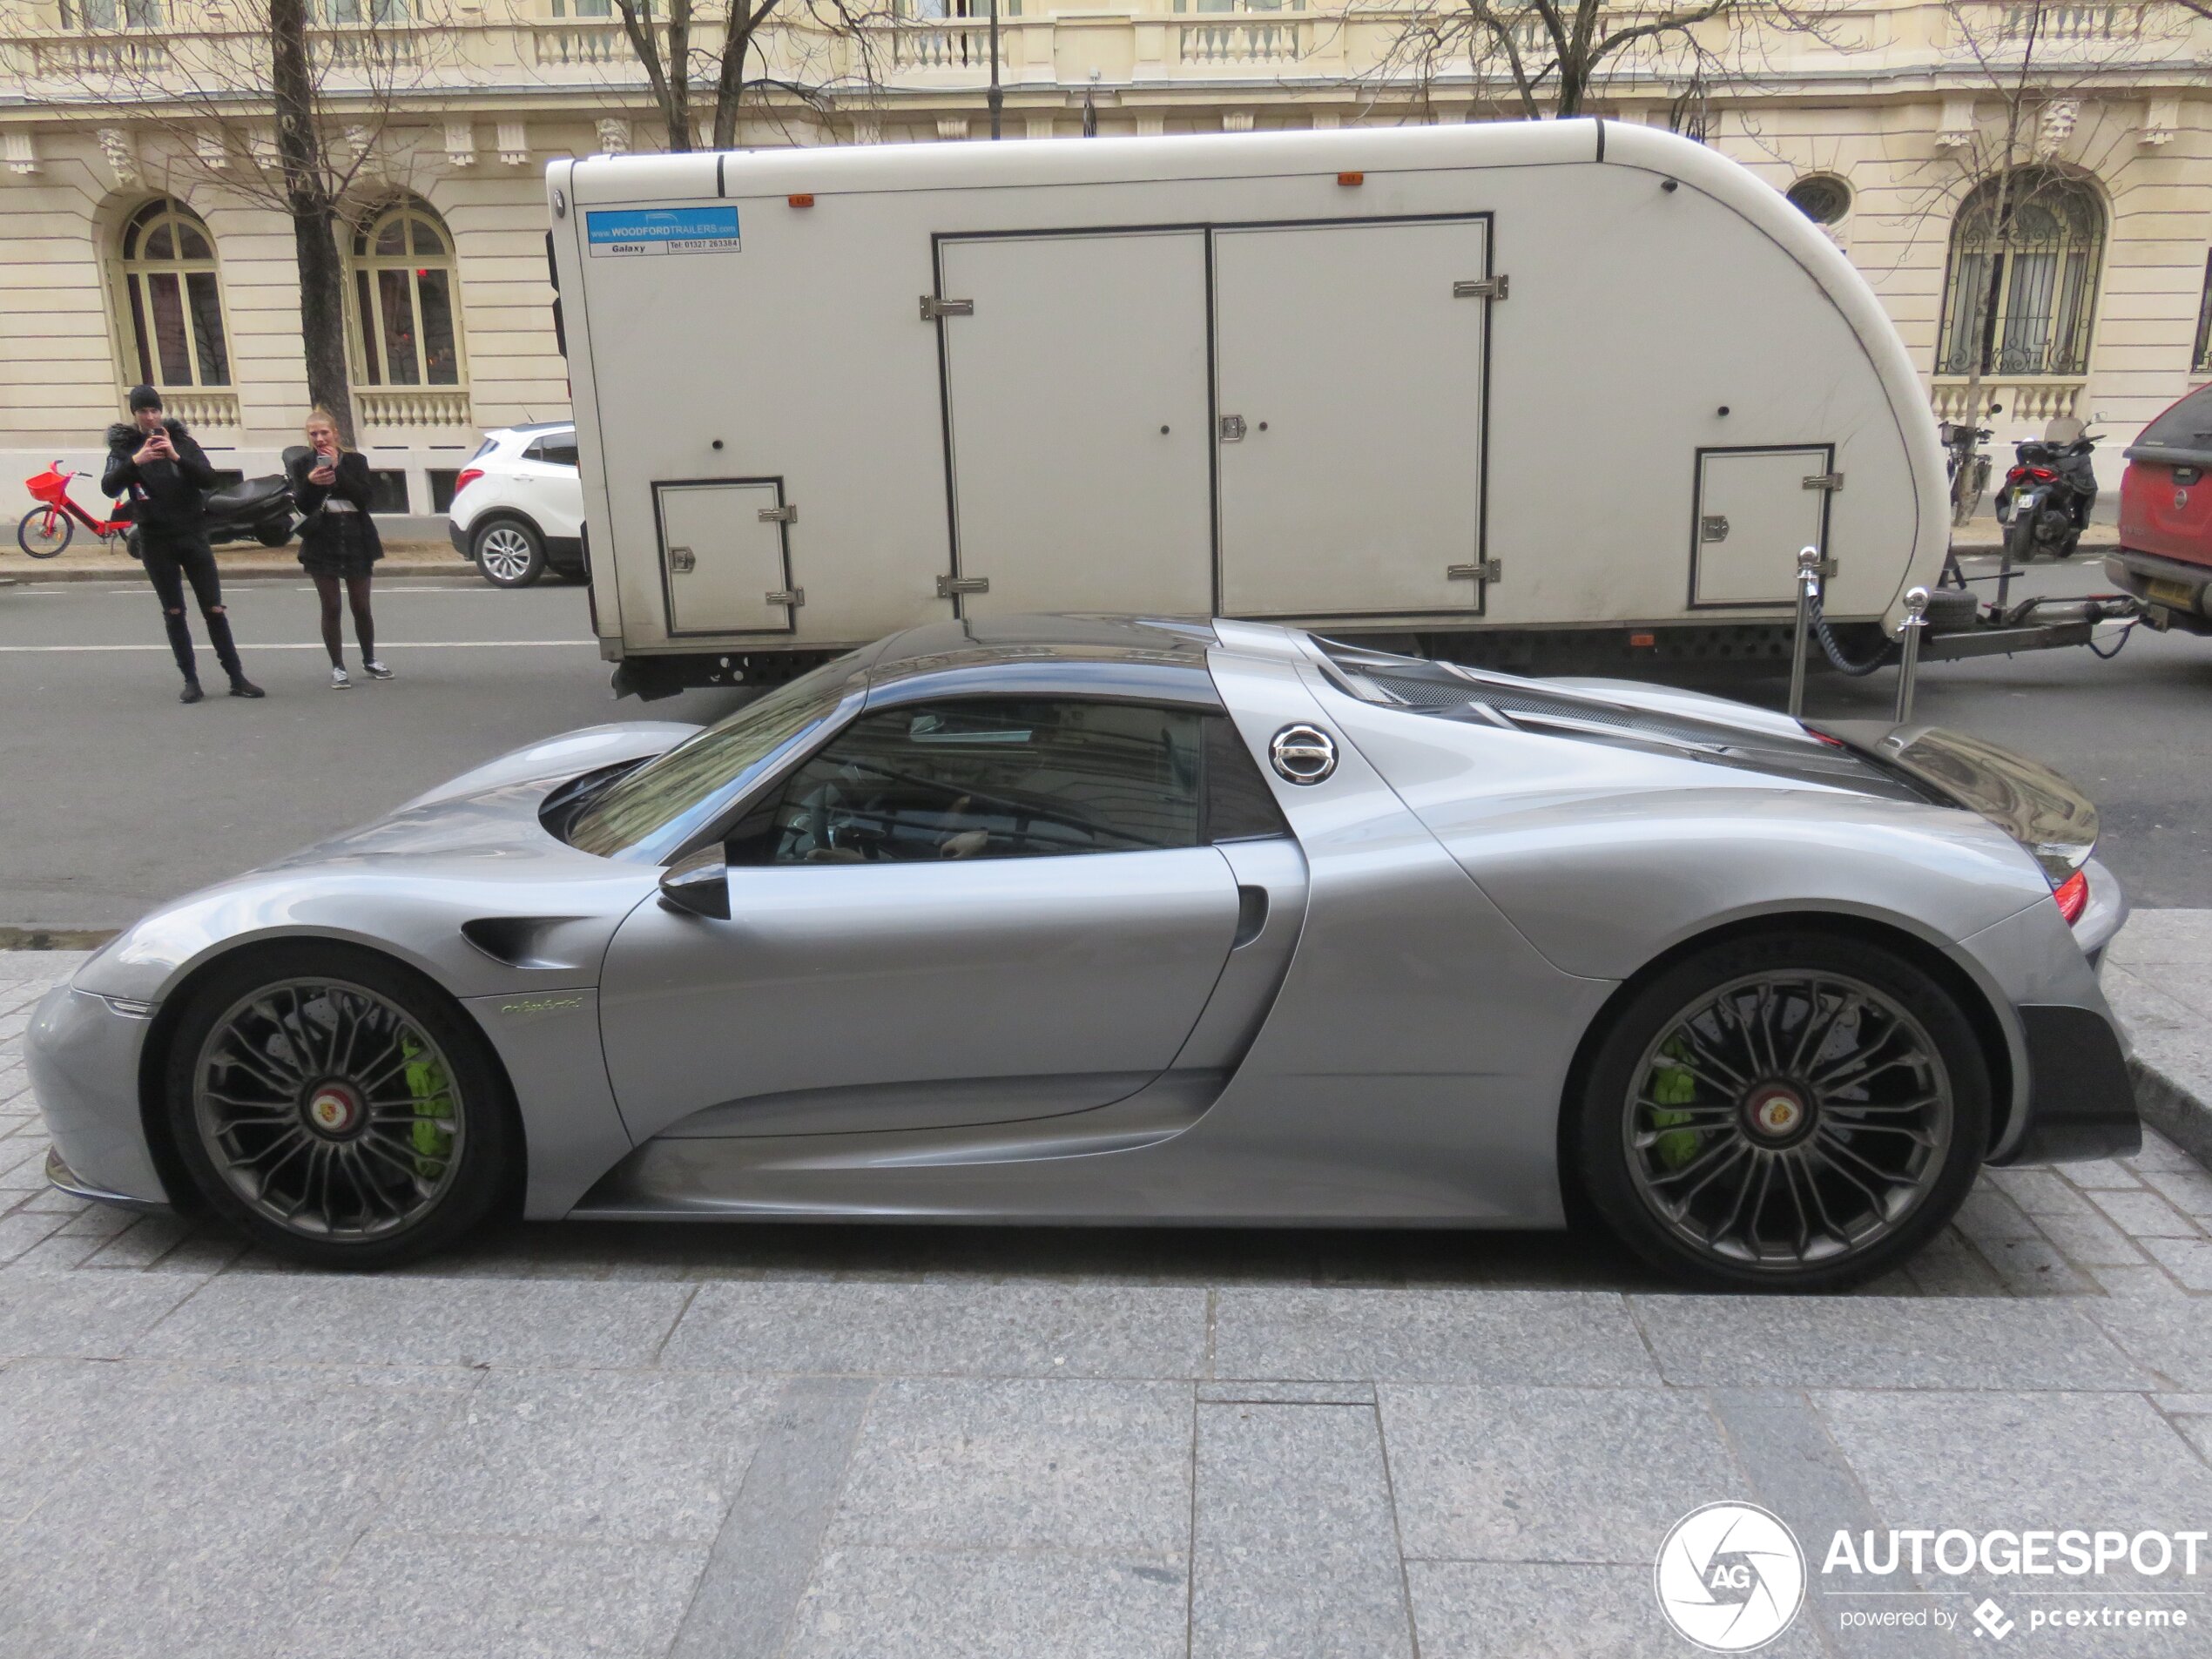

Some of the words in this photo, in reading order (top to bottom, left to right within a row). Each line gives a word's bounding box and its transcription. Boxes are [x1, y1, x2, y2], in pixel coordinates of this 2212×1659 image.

[685, 240, 706, 249] 01327
[709, 239, 738, 248] 263384
[612, 245, 645, 253] Galaxy
